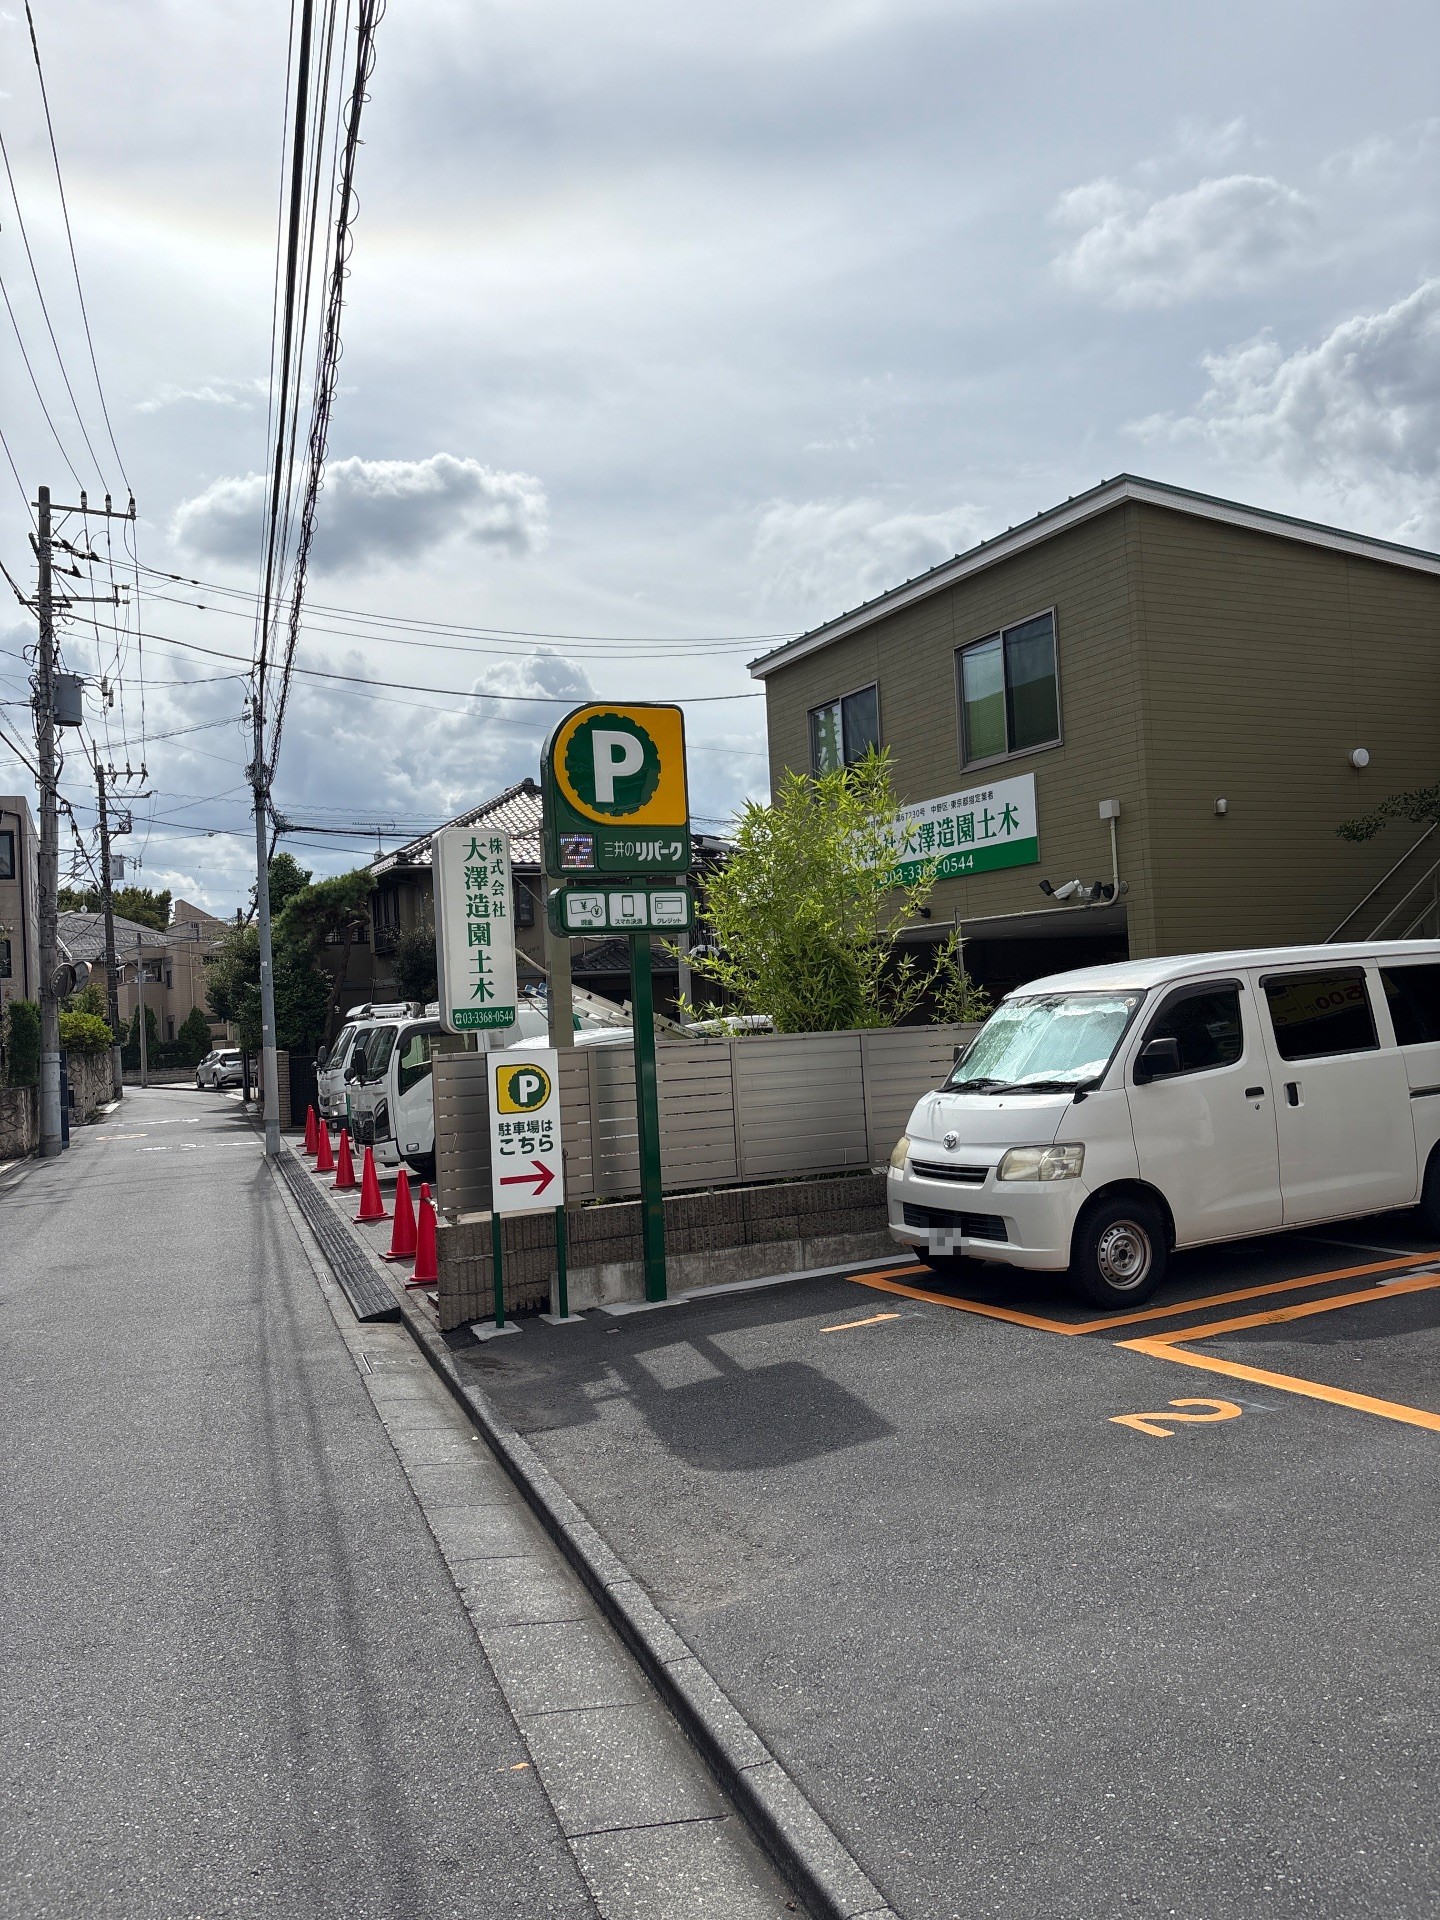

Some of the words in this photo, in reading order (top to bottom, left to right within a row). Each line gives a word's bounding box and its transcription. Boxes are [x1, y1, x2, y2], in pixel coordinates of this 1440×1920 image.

[592, 730, 644, 803] P
[604, 840, 682, 862] 三井のリパーク
[489, 837, 506, 918] 株式会社
[463, 836, 495, 1003] 大澤造園土木
[462, 1010, 514, 1025] 03-3368-0544
[518, 1074, 540, 1103] P
[498, 1119, 553, 1137] 駐車場は
[499, 1134, 554, 1155] こちら
[1107, 1398, 1243, 1438] 2
